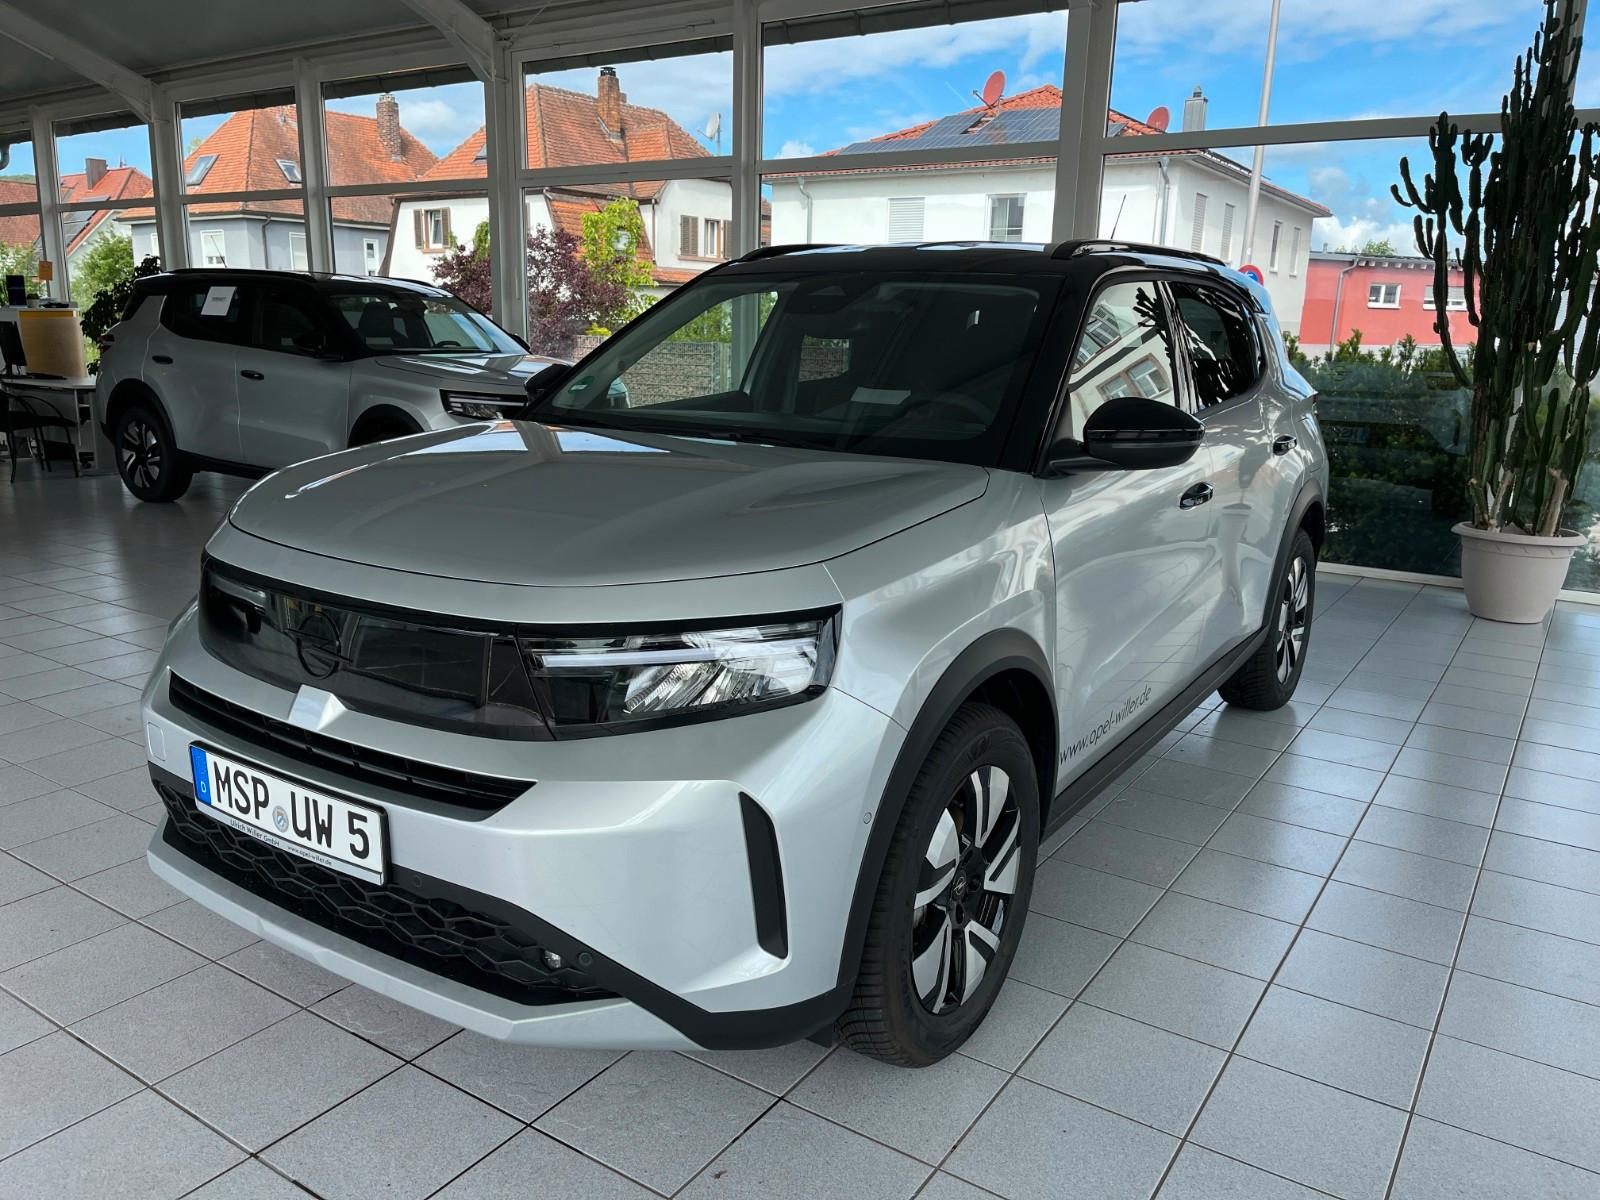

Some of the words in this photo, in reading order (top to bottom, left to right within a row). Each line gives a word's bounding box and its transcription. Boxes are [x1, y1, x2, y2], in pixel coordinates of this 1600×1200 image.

[1059, 684, 1152, 765] www.opel-willer.de
[200, 781, 207, 793] D
[213, 761, 269, 820] MSP
[290, 791, 333, 849] UW
[347, 810, 370, 860] 5
[230, 819, 246, 831] Ulrich
[246, 826, 262, 839] Willer
[263, 835, 280, 846] GmbH
[287, 845, 332, 866] www.opel-willer.de
